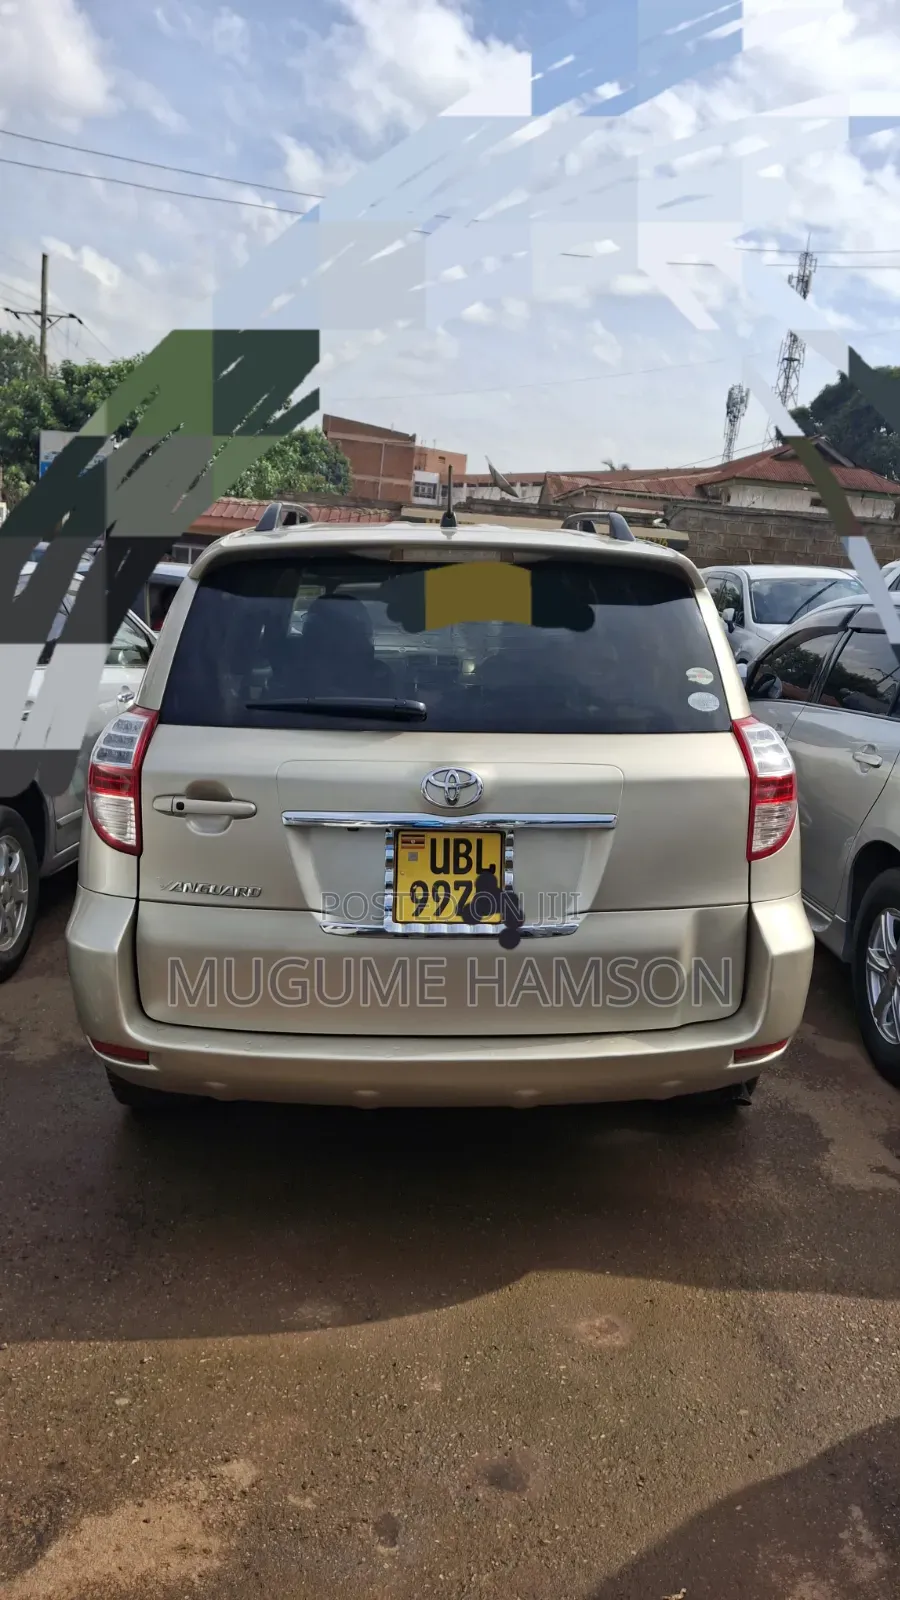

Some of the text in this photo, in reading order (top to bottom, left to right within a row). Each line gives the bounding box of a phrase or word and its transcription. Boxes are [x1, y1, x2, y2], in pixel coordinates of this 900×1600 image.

[430, 838, 496, 875] UBL
[159, 878, 262, 898] VANGUARD
[410, 880, 498, 917] 997
